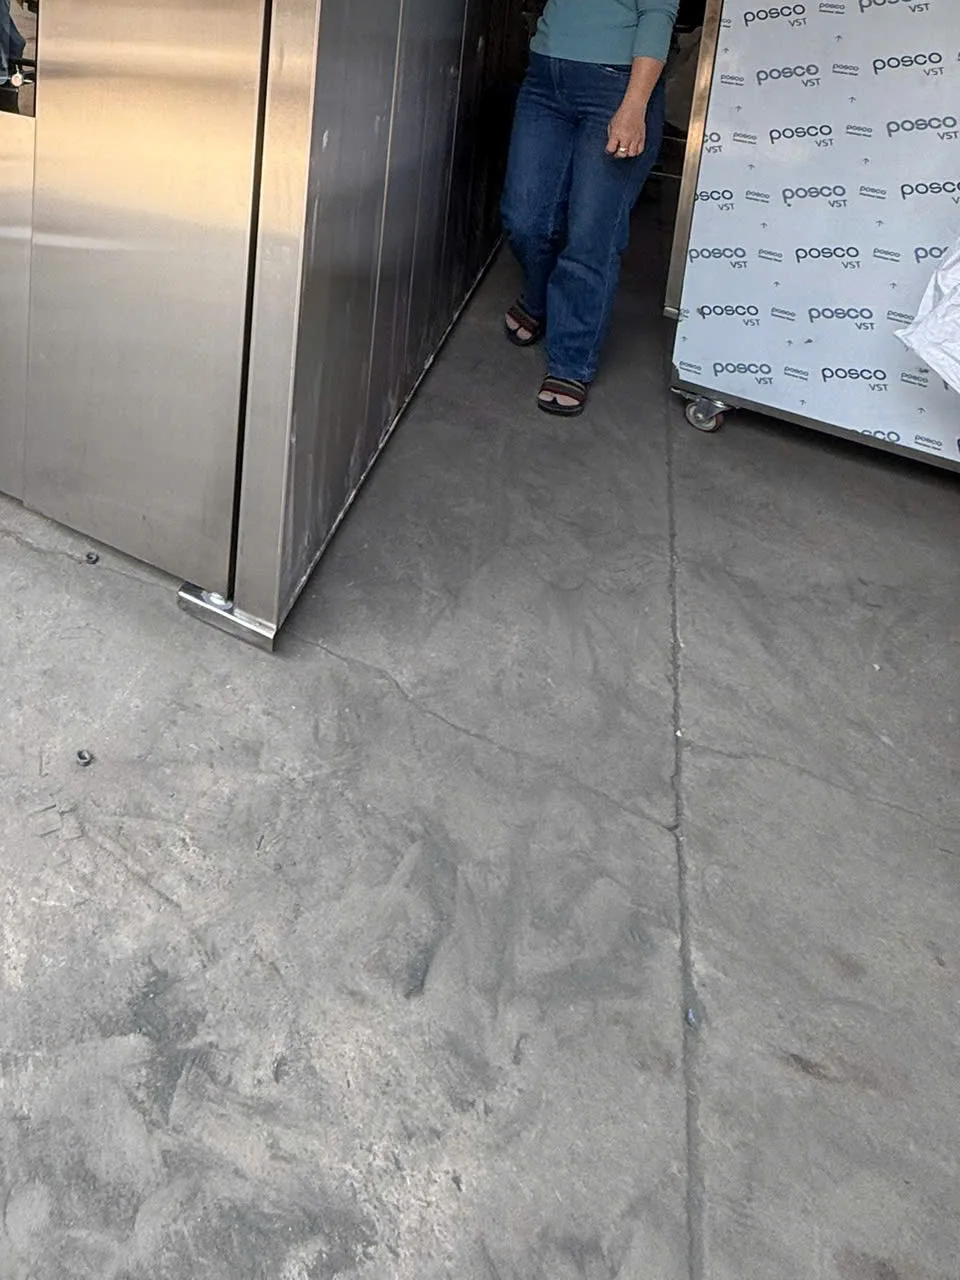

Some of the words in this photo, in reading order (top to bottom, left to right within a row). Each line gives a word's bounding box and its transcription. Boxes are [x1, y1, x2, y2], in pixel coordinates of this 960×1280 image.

[909, 3, 930, 13] VST
[744, 4, 805, 27] posco
[788, 17, 807, 28] VST
[872, 52, 942, 75] posco
[756, 64, 819, 86] posco
[923, 67, 944, 76] VST
[801, 78, 821, 87] VST
[886, 117, 957, 137] posco
[769, 125, 832, 144] posco
[937, 131, 959, 140] VST
[815, 139, 834, 147] VST
[705, 145, 723, 153] VST
[783, 186, 846, 203] posco
[718, 203, 735, 211] VST
[828, 199, 847, 208] VST
[689, 248, 746, 262] posco
[796, 247, 859, 263] posco
[730, 261, 748, 269] VST
[842, 261, 862, 269] VST
[700, 305, 758, 319] posco
[808, 308, 873, 323] posco
[855, 322, 874, 330] VST
[713, 362, 771, 376] posco
[822, 368, 886, 382] posco
[755, 377, 773, 385] VST
[869, 383, 888, 391] VST
